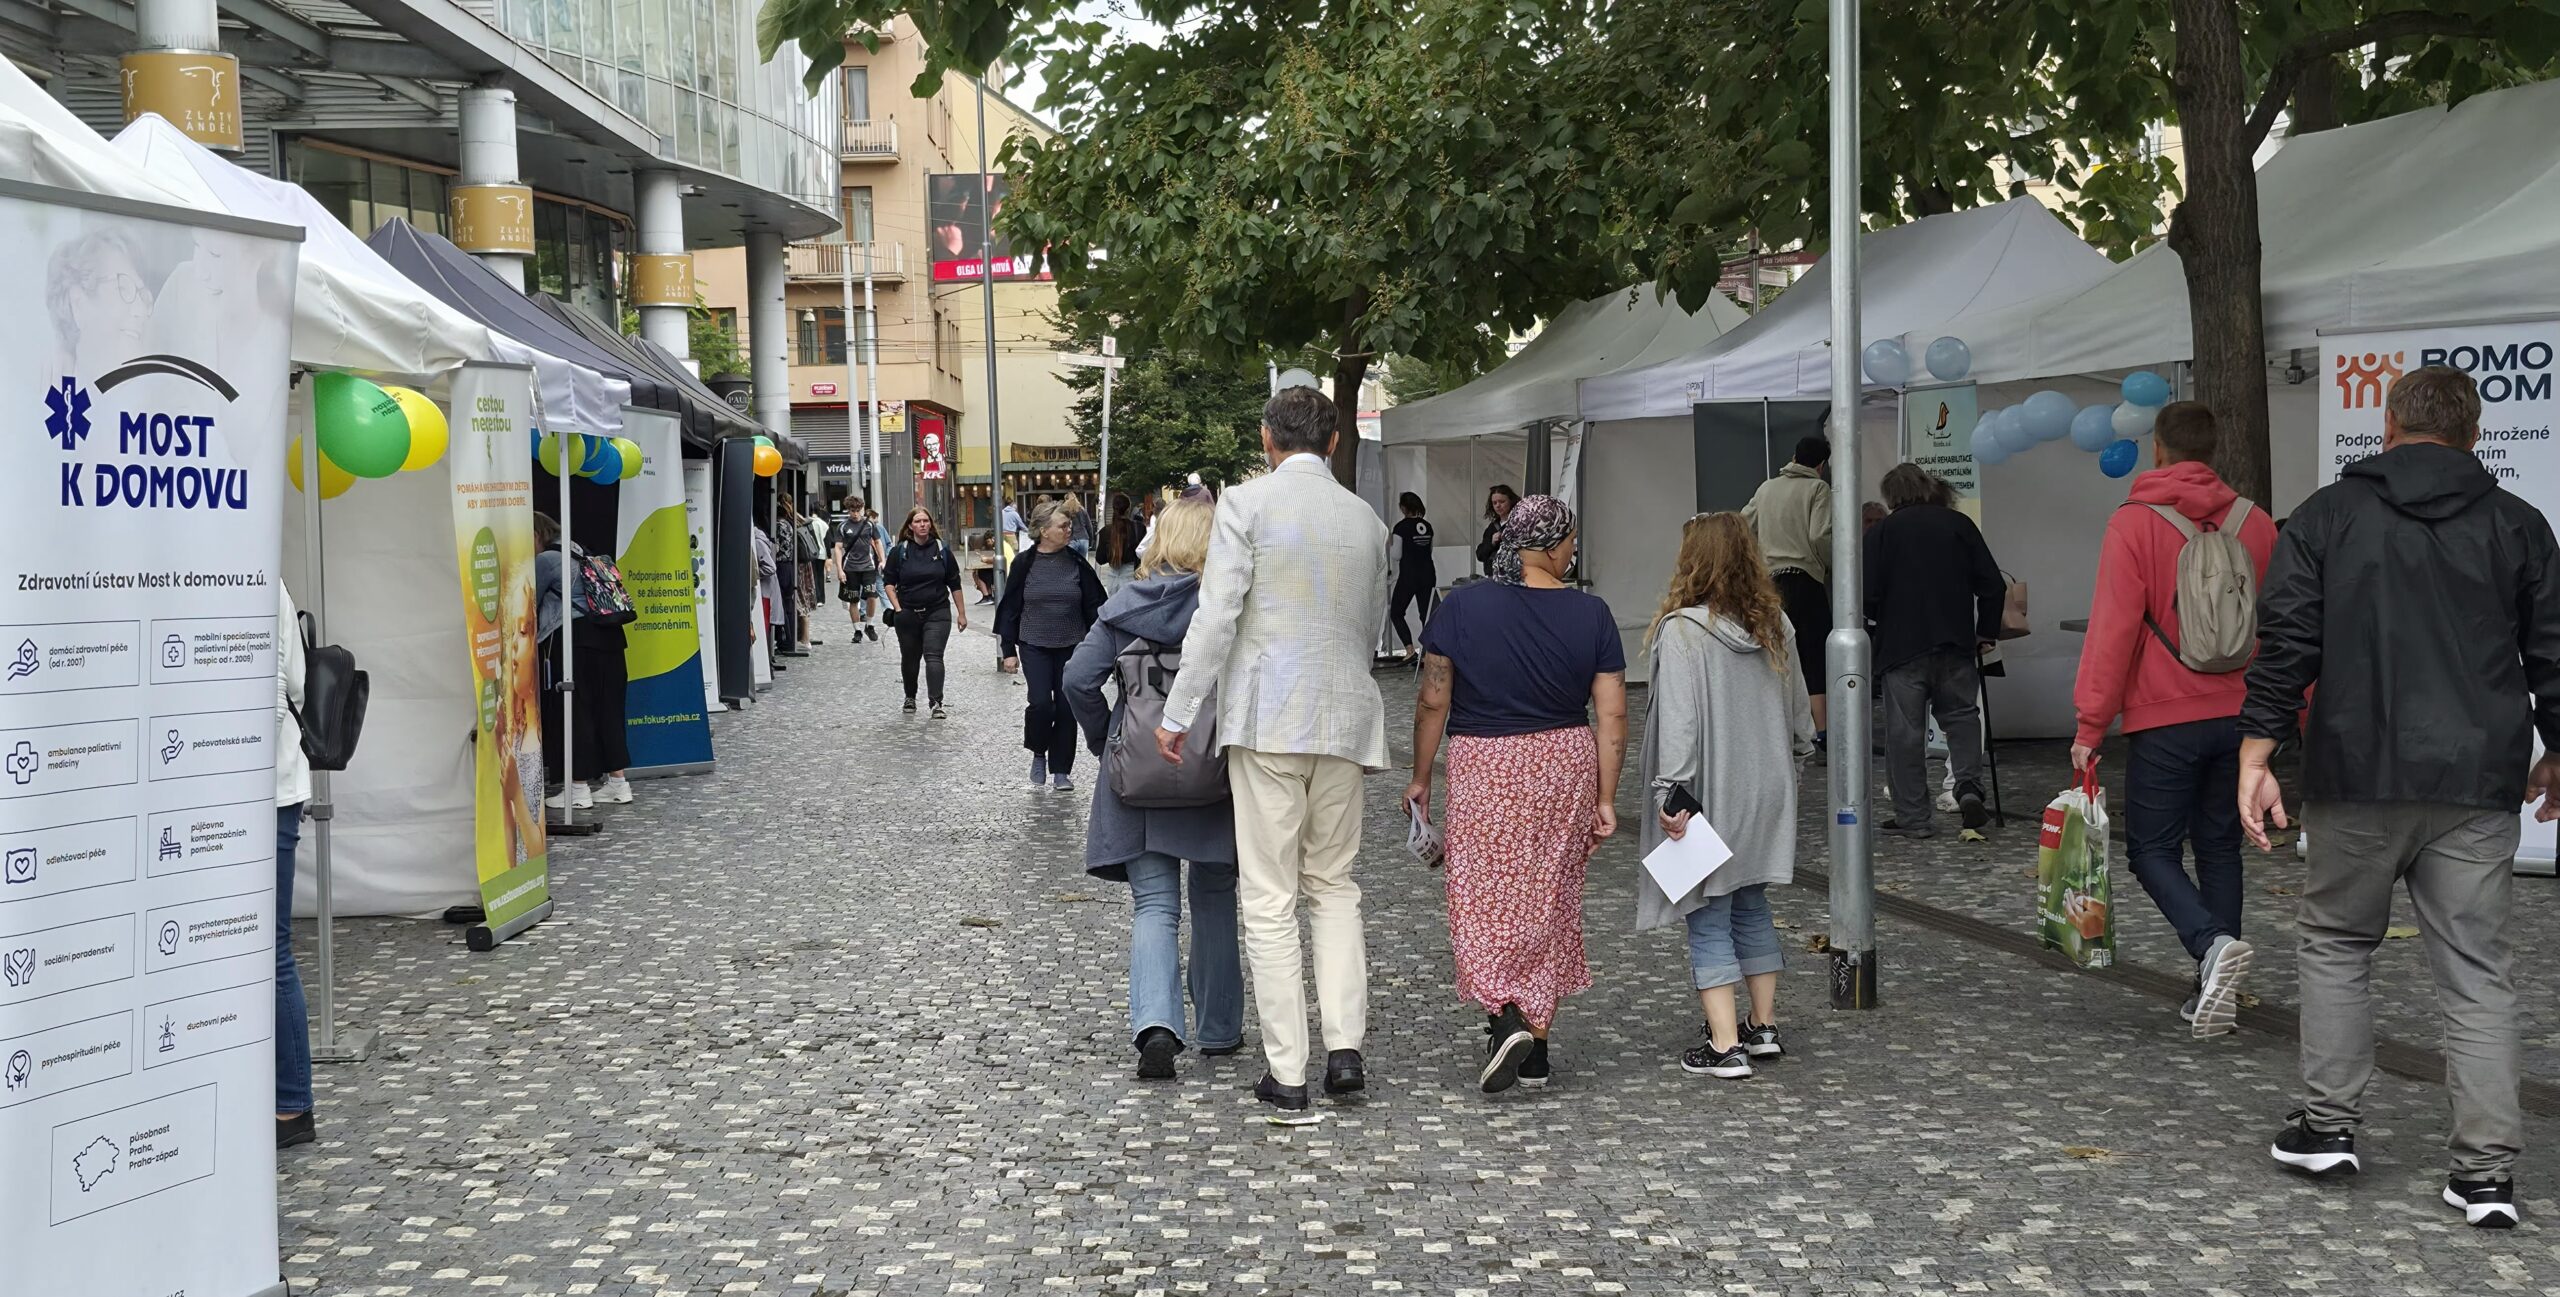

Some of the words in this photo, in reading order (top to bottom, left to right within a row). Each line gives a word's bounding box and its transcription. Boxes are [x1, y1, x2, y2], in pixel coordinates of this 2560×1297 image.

[956, 264, 976, 277] OLGA
[476, 395, 505, 413] cestou
[471, 415, 512, 432] necestou
[119, 411, 215, 458] MOST
[923, 471, 946, 480] KFC
[61, 462, 84, 506] K
[95, 463, 248, 510] DOMOVU
[18, 571, 91, 591] Zdravotní
[92, 572, 135, 589] ústav
[138, 571, 171, 589] Most
[173, 570, 182, 588] k
[183, 570, 245, 588] domovu
[246, 571, 268, 587] z.ú.
[628, 569, 673, 583] Podporujeme
[674, 569, 689, 581] lidi
[637, 588, 646, 598] se
[647, 585, 691, 598] zkušenosti
[644, 606, 649, 614] s
[650, 603, 692, 614] duševním
[633, 618, 693, 632] onemocněním.
[194, 632, 222, 643] mobilní
[223, 630, 271, 643] specializovaná
[49, 644, 76, 657] domácí
[76, 642, 110, 654] zdravotní
[110, 642, 128, 655] péče
[194, 643, 229, 655] paliativní
[229, 643, 246, 654] péče
[247, 641, 272, 653] (mobilní
[48, 656, 61, 670] (od
[67, 655, 86, 668] 2007)
[194, 655, 218, 667] hospic
[219, 655, 229, 664] od
[235, 653, 254, 664] 2009)
[627, 713, 701, 726] www.fokus-praha.cz
[48, 746, 87, 758] ambulance
[87, 740, 122, 756] paliativní
[192, 737, 241, 751] pečovatelská
[241, 735, 262, 744] služba
[48, 758, 80, 770] medicíny
[191, 820, 225, 833] půjčovna
[190, 828, 248, 843] kompenzačních
[46, 850, 88, 865] odlehčovací
[88, 848, 107, 860] péče
[190, 842, 224, 857] pomůcek
[189, 911, 258, 933] psychoterapeutická
[194, 923, 243, 945] psychiatrická
[243, 923, 259, 936] péče
[44, 951, 72, 967] sociální
[72, 943, 115, 962] poradenství
[187, 1015, 219, 1031] duchovní
[220, 1012, 237, 1025] péče
[42, 1043, 103, 1070] psychospirituální
[103, 1039, 121, 1054] péče
[129, 1124, 170, 1147] působnost
[129, 1143, 154, 1157] Praha,
[129, 1146, 179, 1170] Praha-západ
